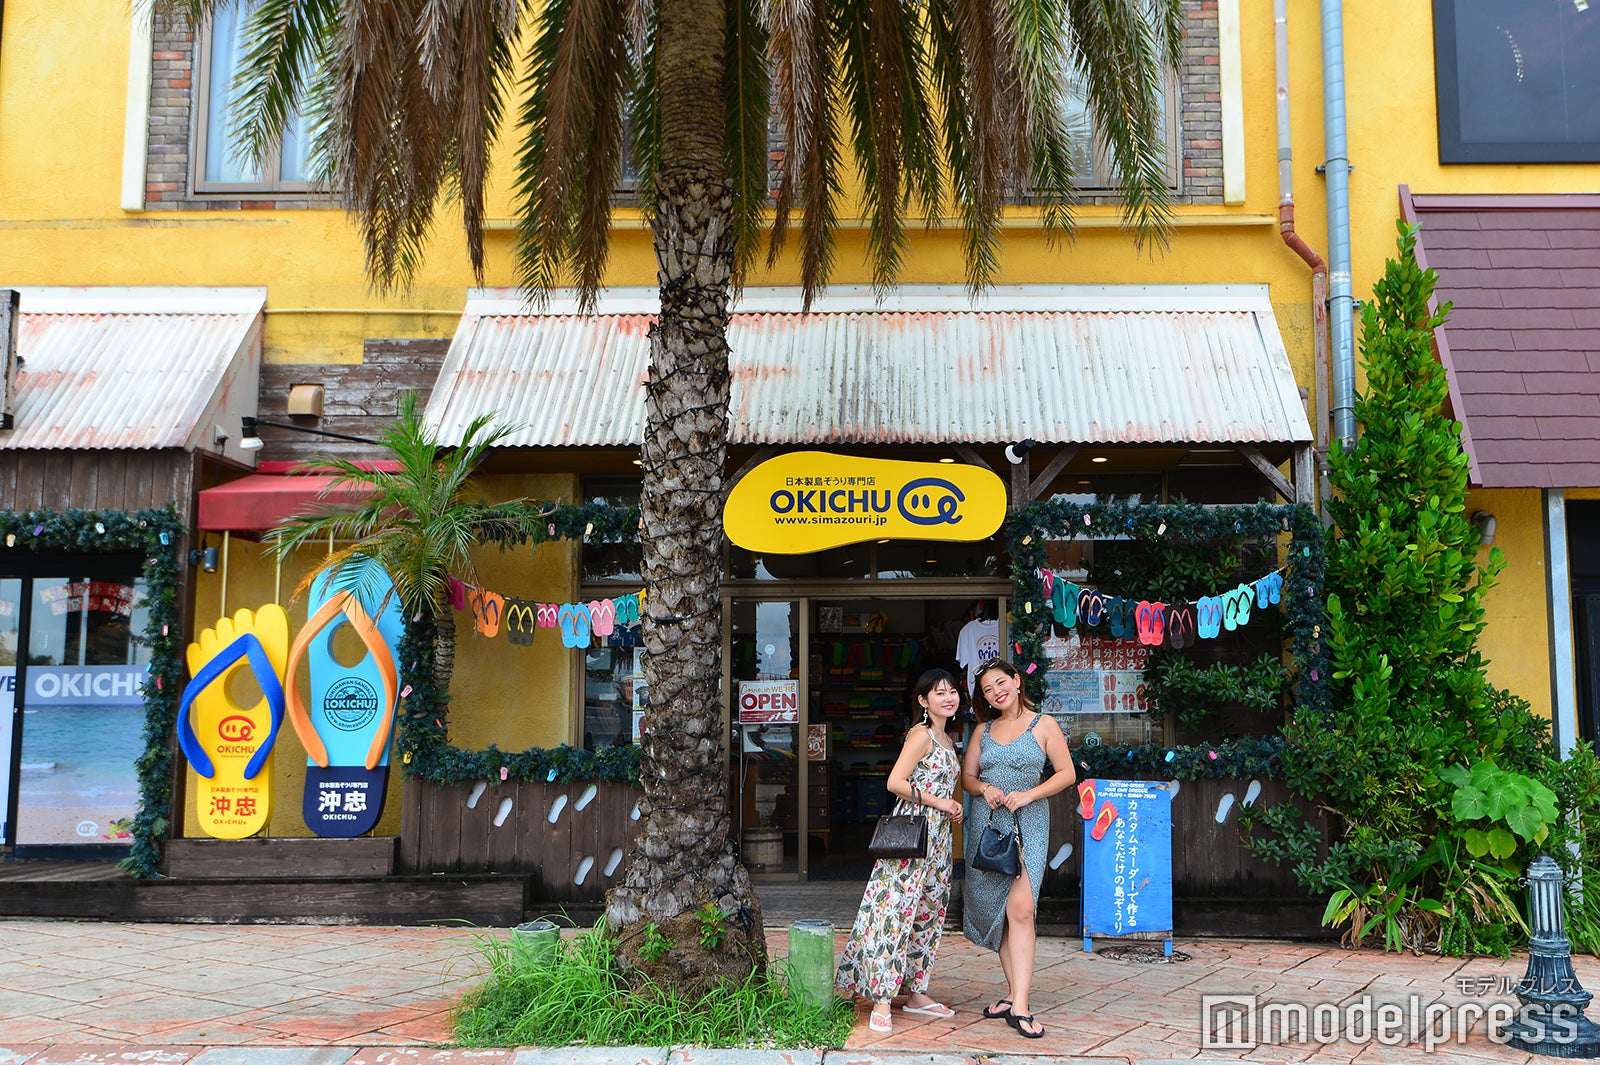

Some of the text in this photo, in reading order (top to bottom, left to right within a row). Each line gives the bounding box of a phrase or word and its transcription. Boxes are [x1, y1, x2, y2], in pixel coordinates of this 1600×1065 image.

[785, 476, 876, 487] 日本製島ぞうり専門店
[769, 489, 890, 513] OKICHU
[774, 515, 888, 526] www.simazouri.jp
[741, 693, 796, 709] OPEN
[217, 745, 255, 754] OKICHU
[209, 795, 257, 816] 沖忠
[317, 790, 367, 812] 沖忠
[1126, 800, 1139, 926] カスタムオーダーで作る
[1114, 817, 1126, 934] あなただけの島ぞうり
